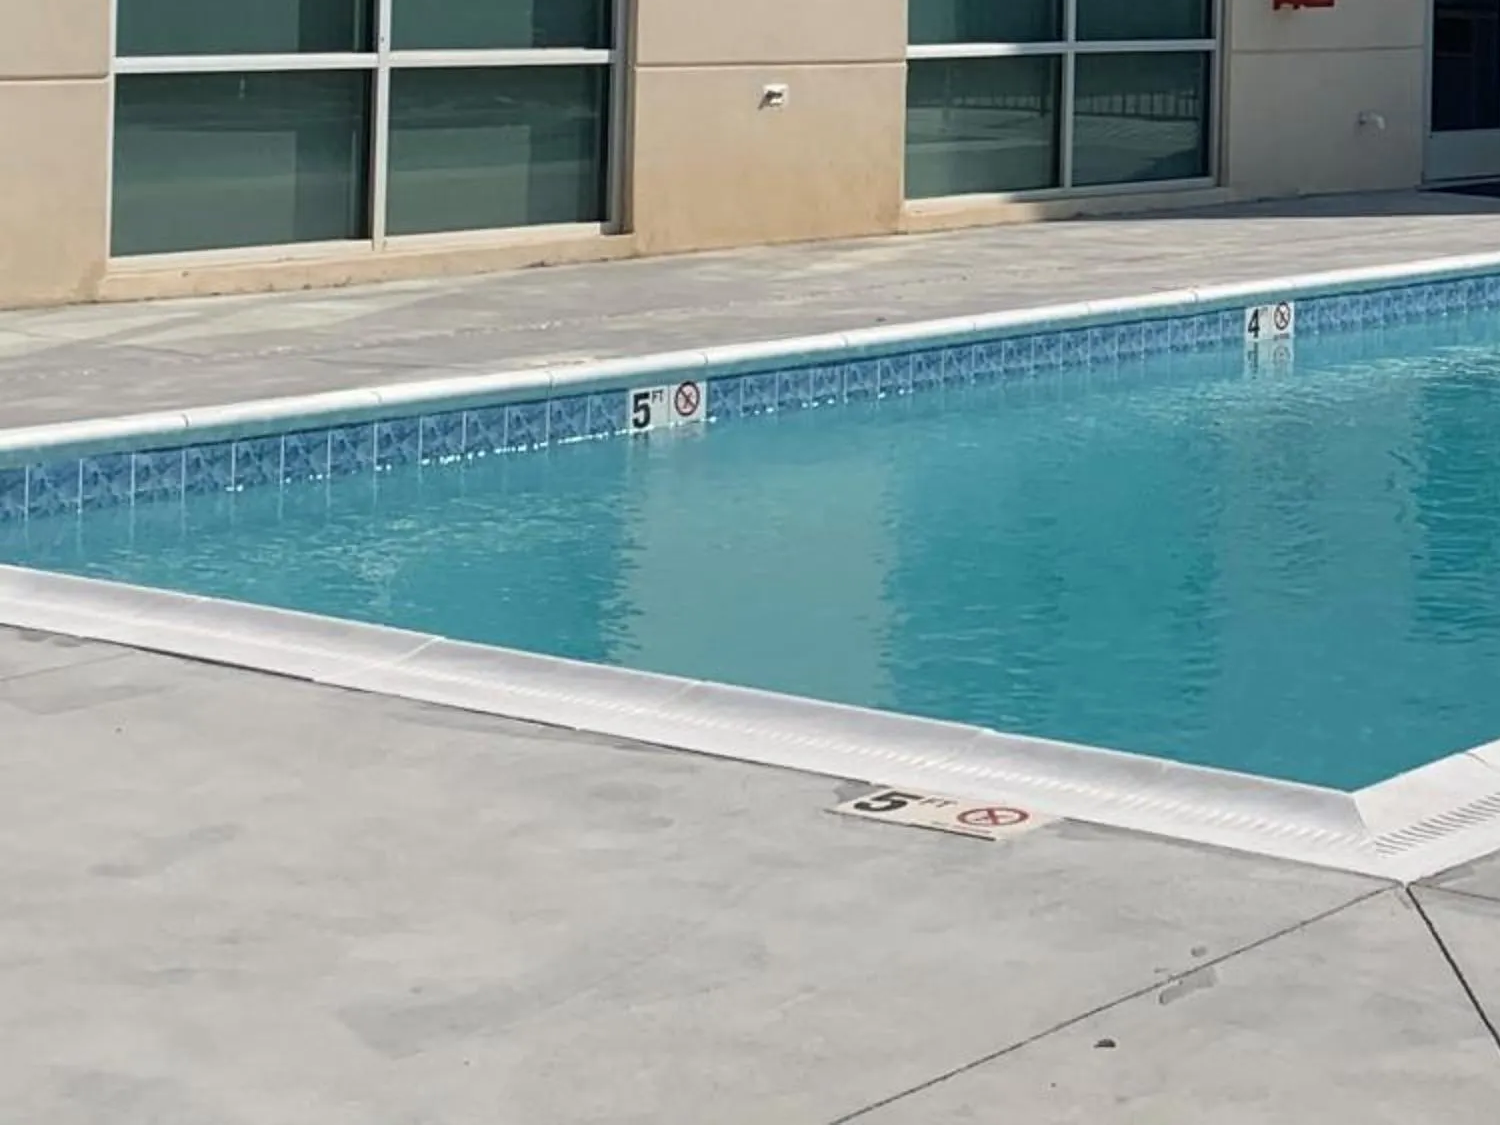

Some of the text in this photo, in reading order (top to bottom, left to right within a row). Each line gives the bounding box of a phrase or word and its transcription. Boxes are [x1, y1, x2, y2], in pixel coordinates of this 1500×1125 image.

[1247, 308, 1260, 339] 4
[632, 389, 664, 429] 5 FT
[853, 790, 924, 813] 5
